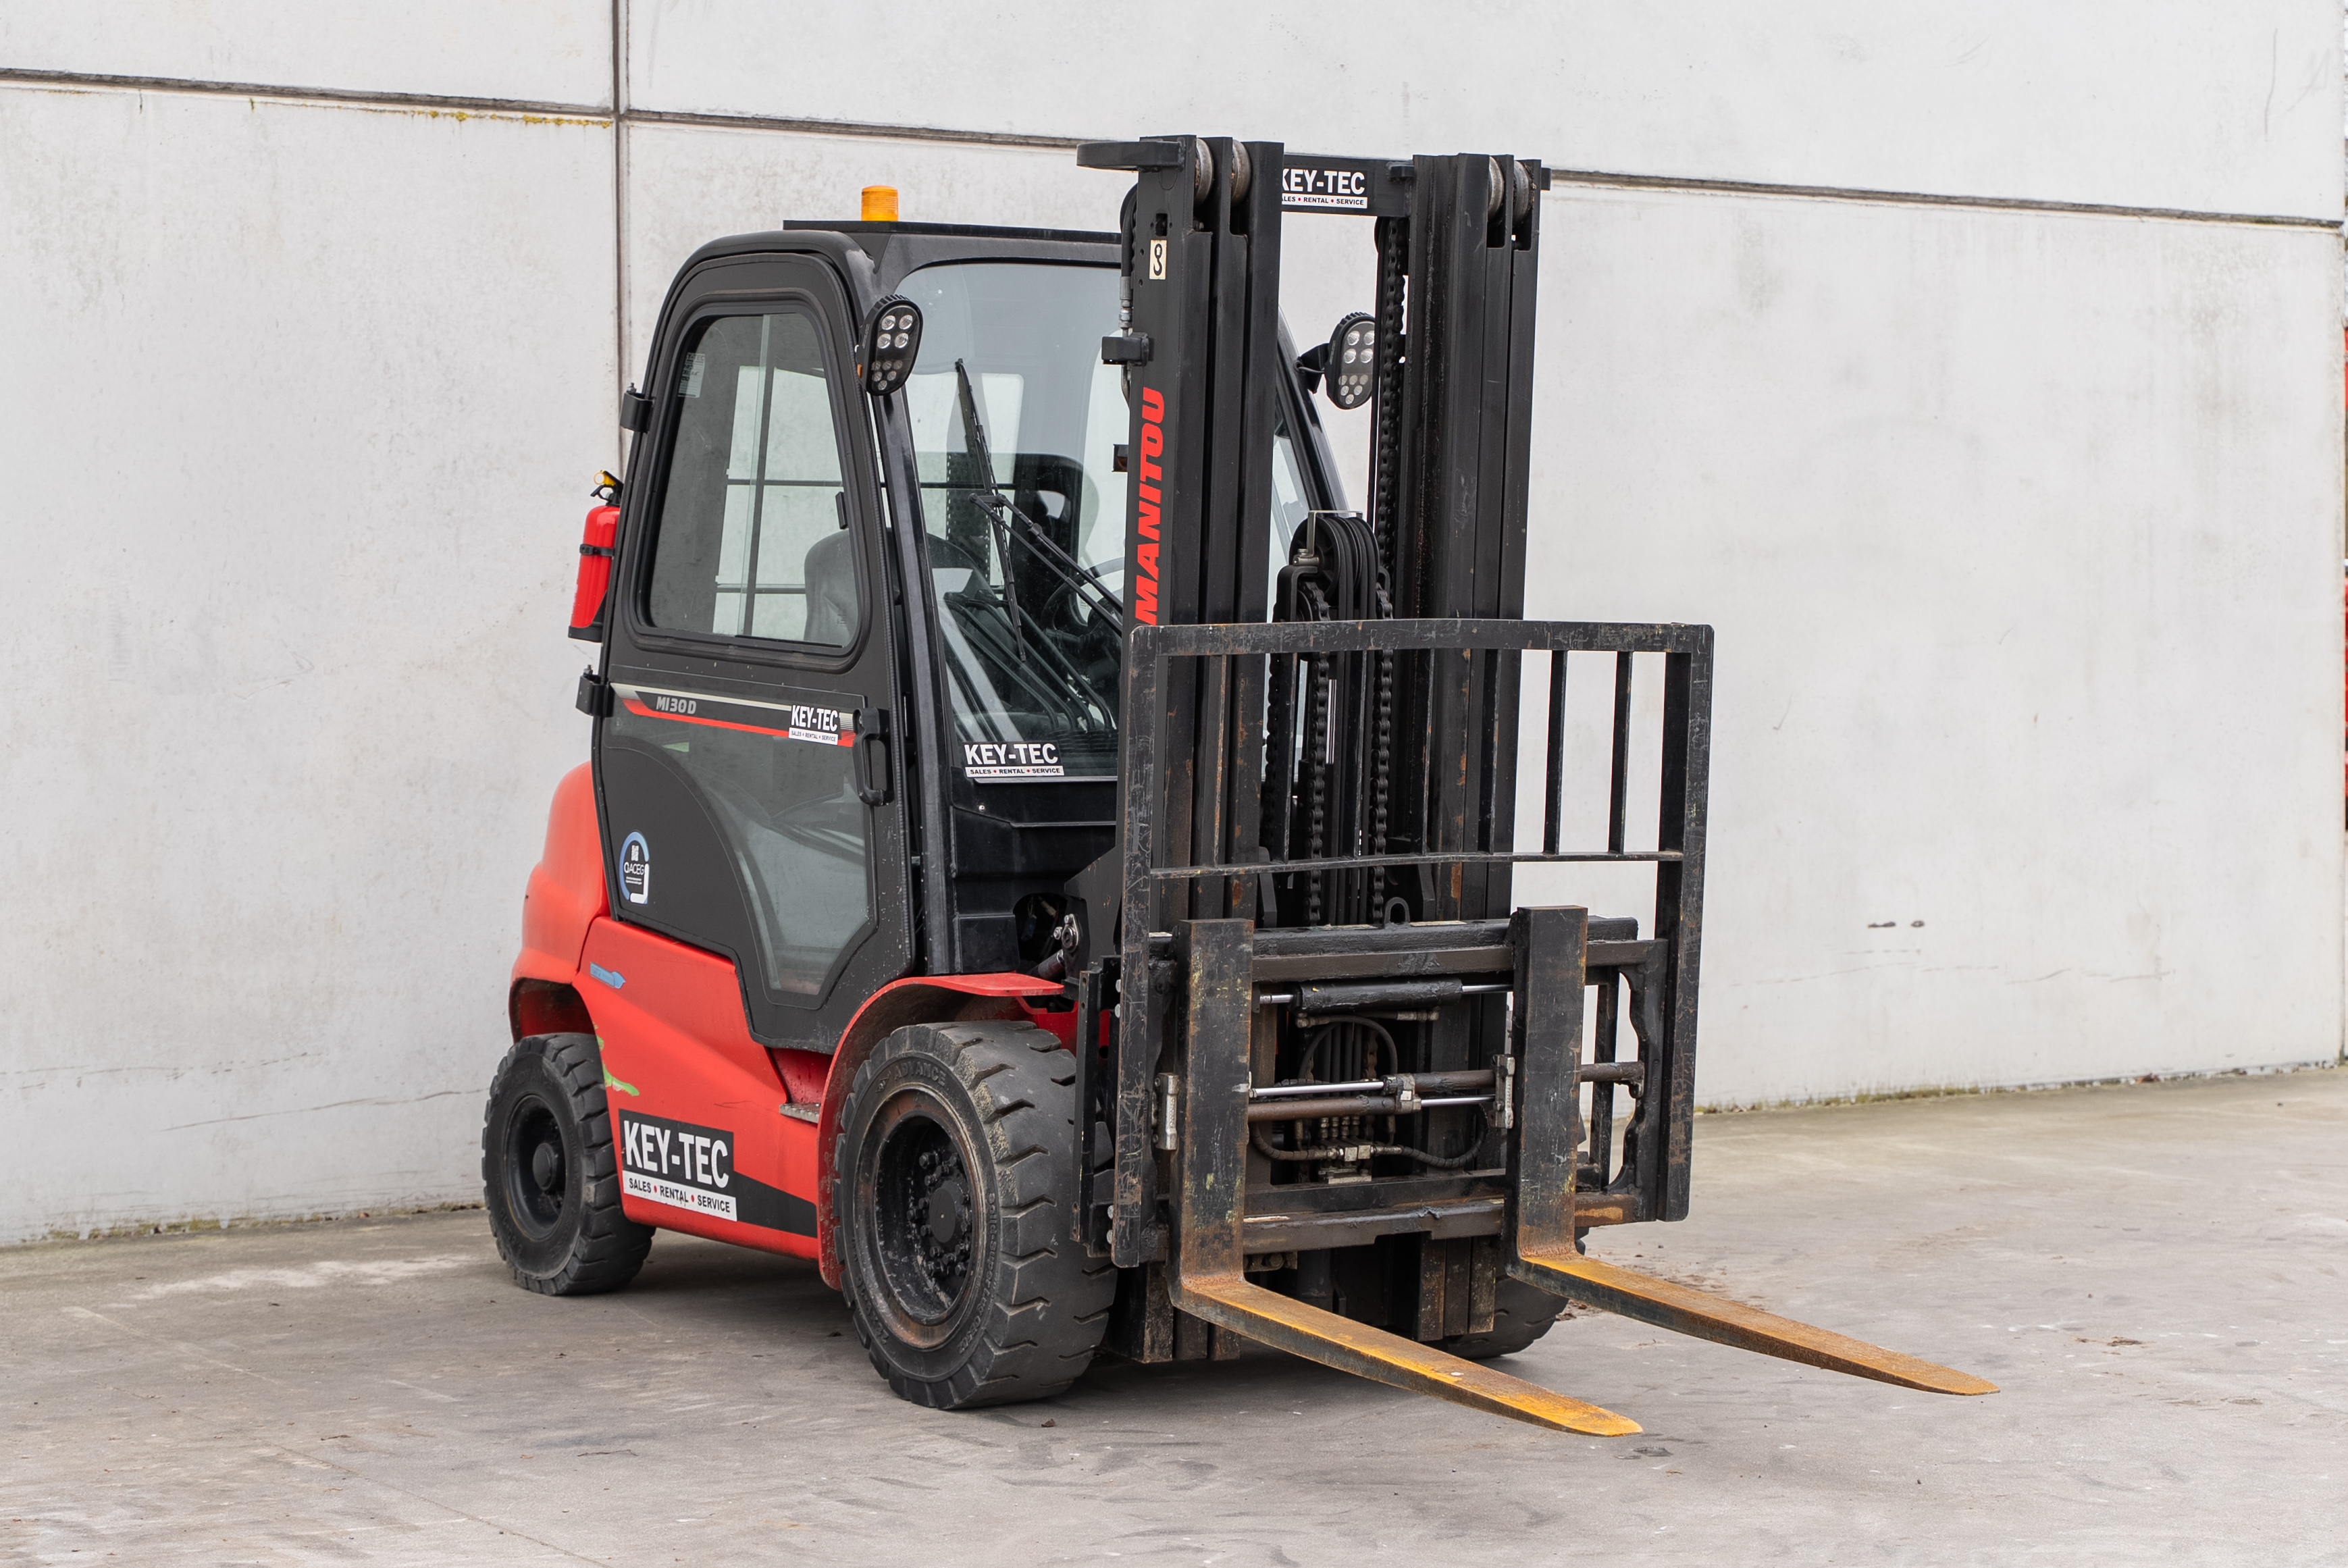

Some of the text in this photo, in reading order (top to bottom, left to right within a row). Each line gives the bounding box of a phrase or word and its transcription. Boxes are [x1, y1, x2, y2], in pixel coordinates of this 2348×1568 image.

[1134, 386, 1165, 625] MANITOU
[791, 704, 838, 731] KEY-TEC
[964, 743, 1058, 764] KEY-TEC
[893, 1061, 947, 1087] ADVANCE
[623, 1120, 729, 1188] KEY-TEC
[629, 1178, 731, 1213] SALES RENTAL SERVICE
